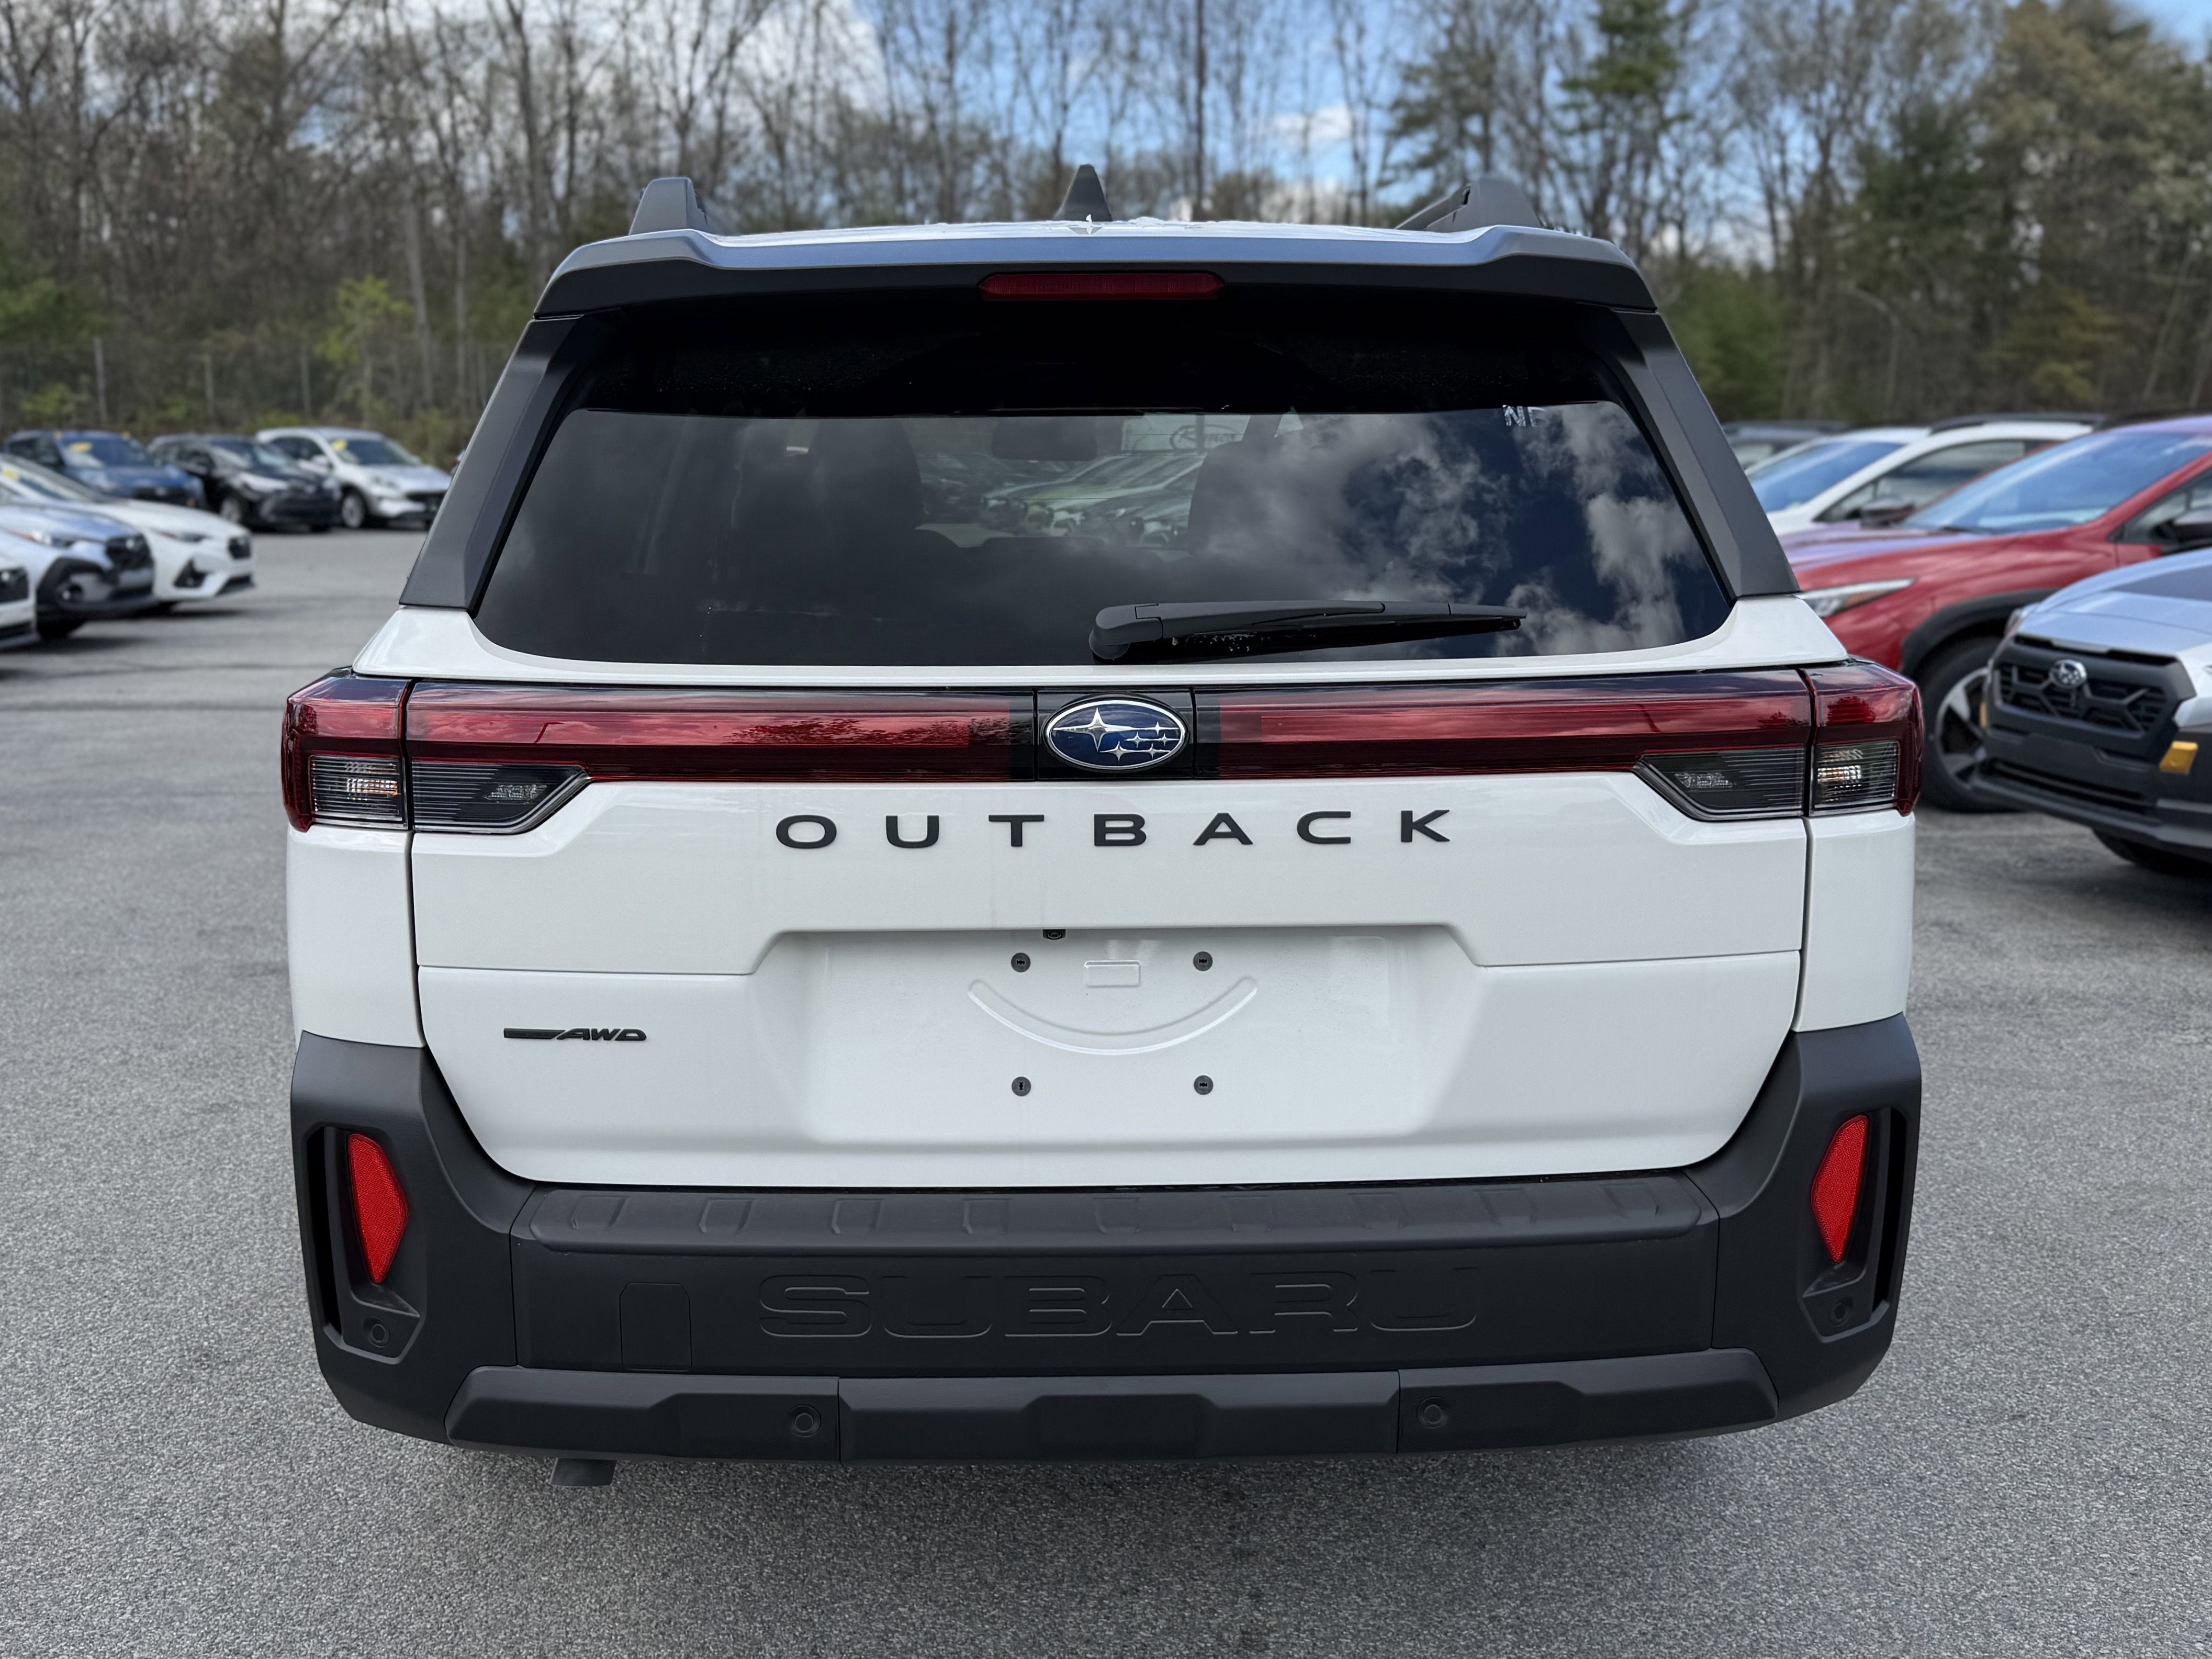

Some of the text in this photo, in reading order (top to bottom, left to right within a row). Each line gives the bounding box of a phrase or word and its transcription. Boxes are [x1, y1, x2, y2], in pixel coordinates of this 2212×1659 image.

[776, 810, 1450, 849] OUTBACK
[556, 1028, 647, 1041] AWD
[759, 1267, 1478, 1338] SUBARU
